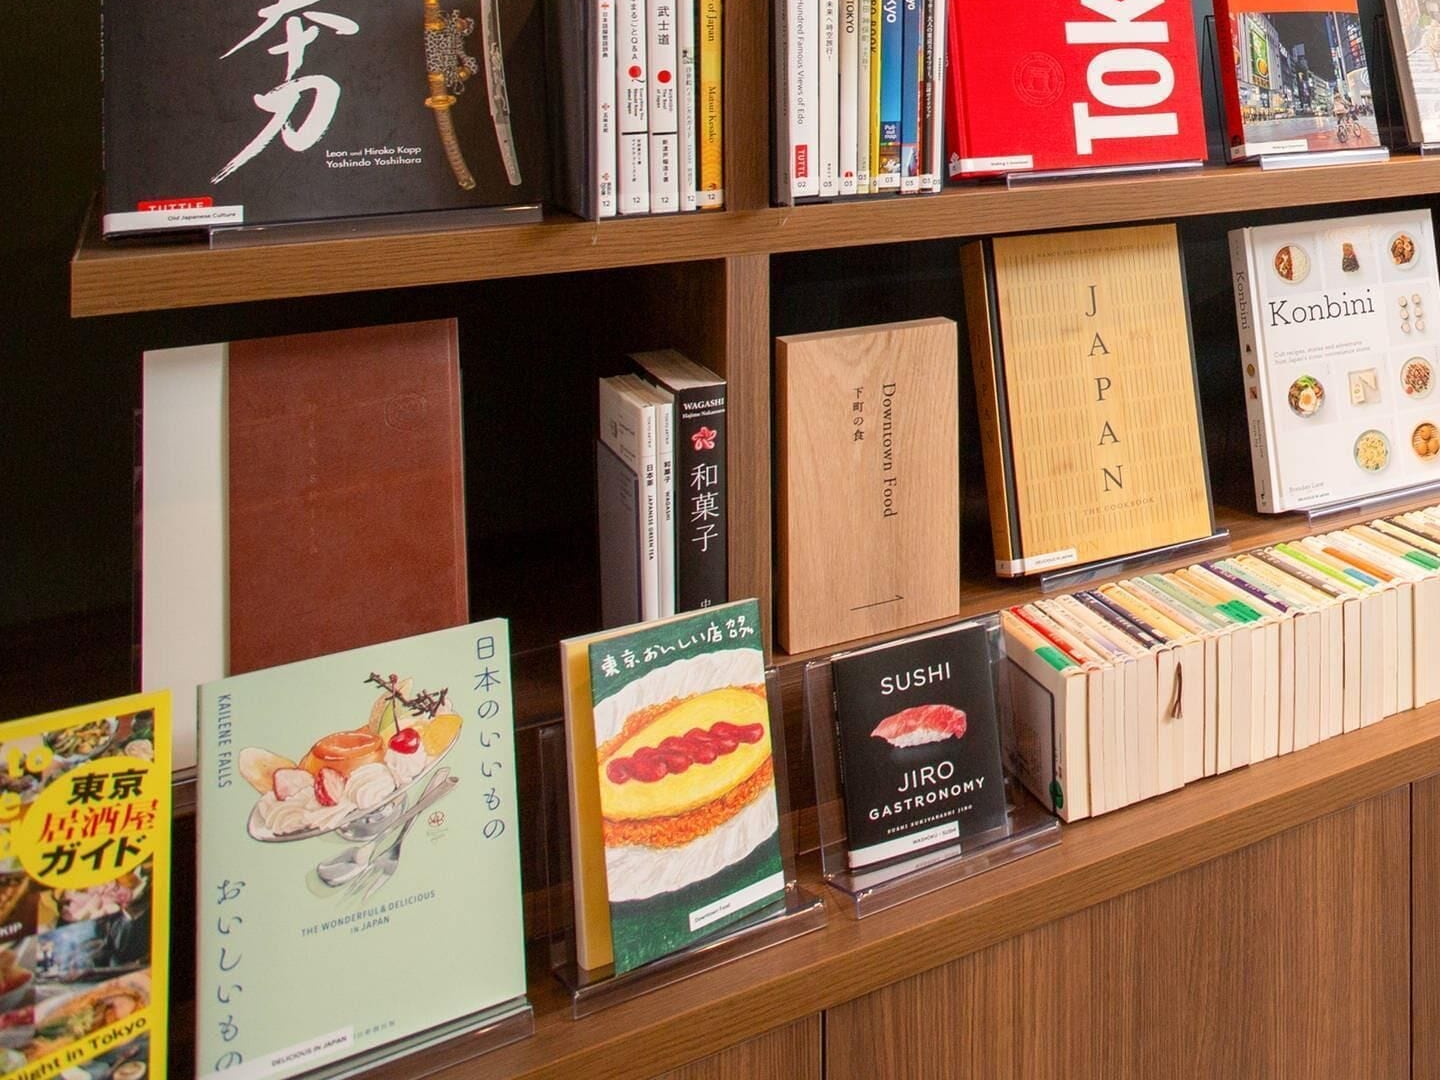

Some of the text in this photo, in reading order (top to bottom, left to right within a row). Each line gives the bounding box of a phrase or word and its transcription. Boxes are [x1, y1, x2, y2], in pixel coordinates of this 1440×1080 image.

[657, 6, 670, 45] 武士道
[845, 0, 855, 34] TOKYO
[326, 145, 422, 158] Leon Hiroko Kapp
[326, 156, 422, 169] Yoshindo Yoshihara
[1236, 271, 1249, 330] Konbini
[1268, 289, 1375, 327] Konbini
[683, 397, 724, 411] WAGASHI
[1085, 284, 1124, 493] JAPAN
[852, 387, 865, 442] 下町の食
[882, 382, 898, 518] Downtown Food
[690, 463, 720, 552] 和菓子
[880, 662, 951, 695] SUSHI
[217, 694, 233, 788] KAILENE FALLS
[474, 635, 505, 841] 日本のいいもの
[68, 769, 148, 806] 東京
[869, 776, 985, 821] GASTRONOMY
[897, 761, 955, 792] JIRO
[39, 799, 158, 844] 居酒屋
[37, 834, 147, 879] ガイド
[301, 890, 436, 937] THE WONDERFUL & DELICIOUS
[350, 916, 390, 934] IN JAPAN
[214, 878, 246, 1072] おいしいもの
[66, 1016, 147, 1062] in Tokyo
[323, 1035, 347, 1049] JAPAN
